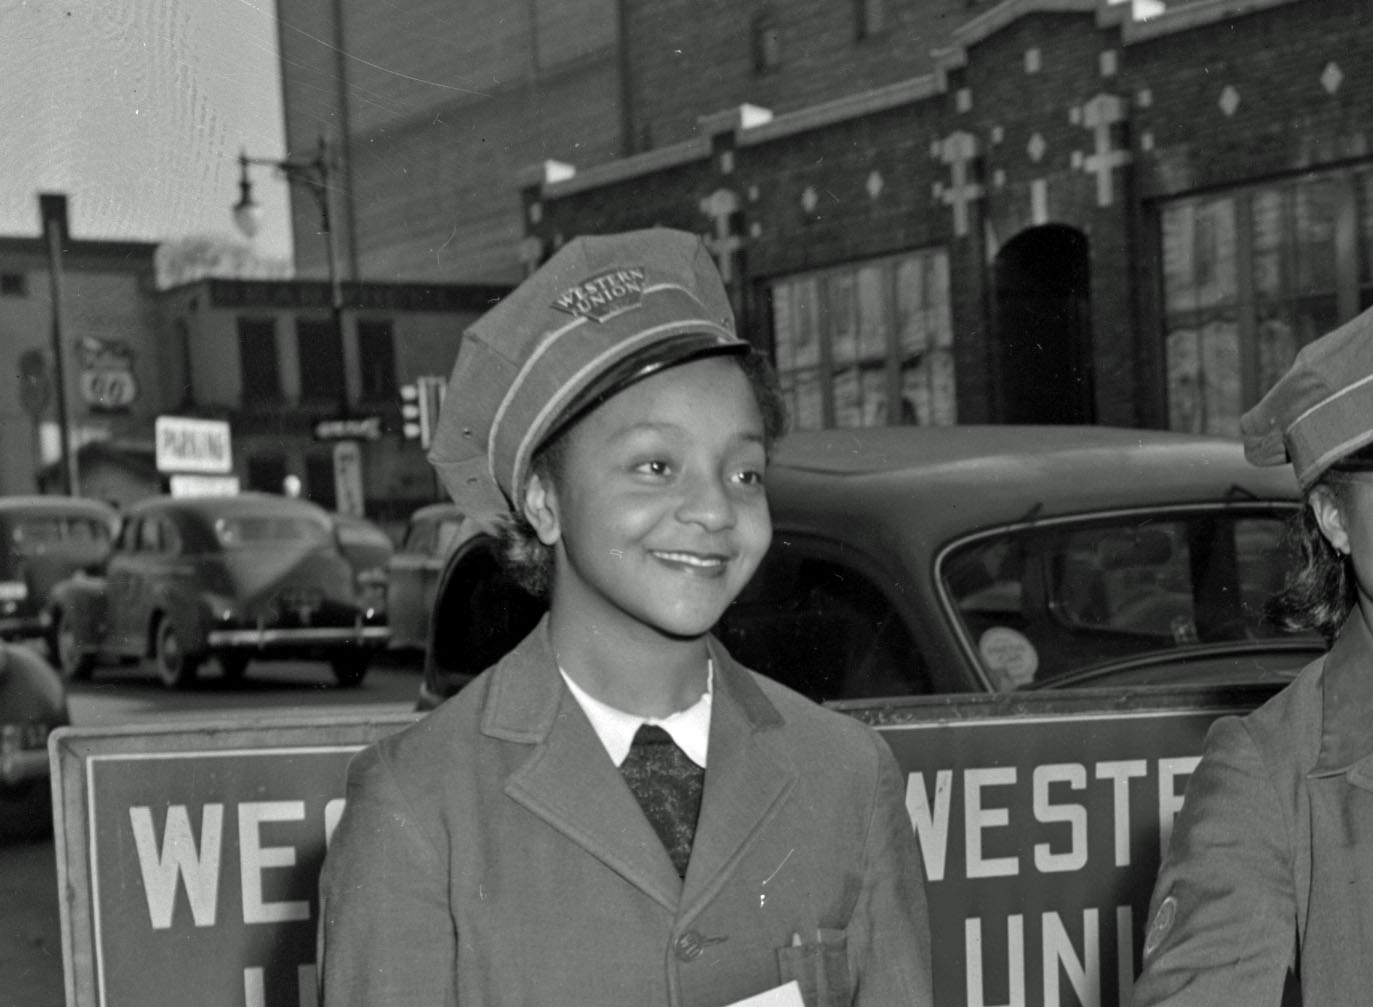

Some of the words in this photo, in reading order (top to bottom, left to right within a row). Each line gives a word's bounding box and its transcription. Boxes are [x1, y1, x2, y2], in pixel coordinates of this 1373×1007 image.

[557, 269, 643, 308] WESTERN
[576, 282, 641, 313] UNION
[129, 798, 347, 930] WE
